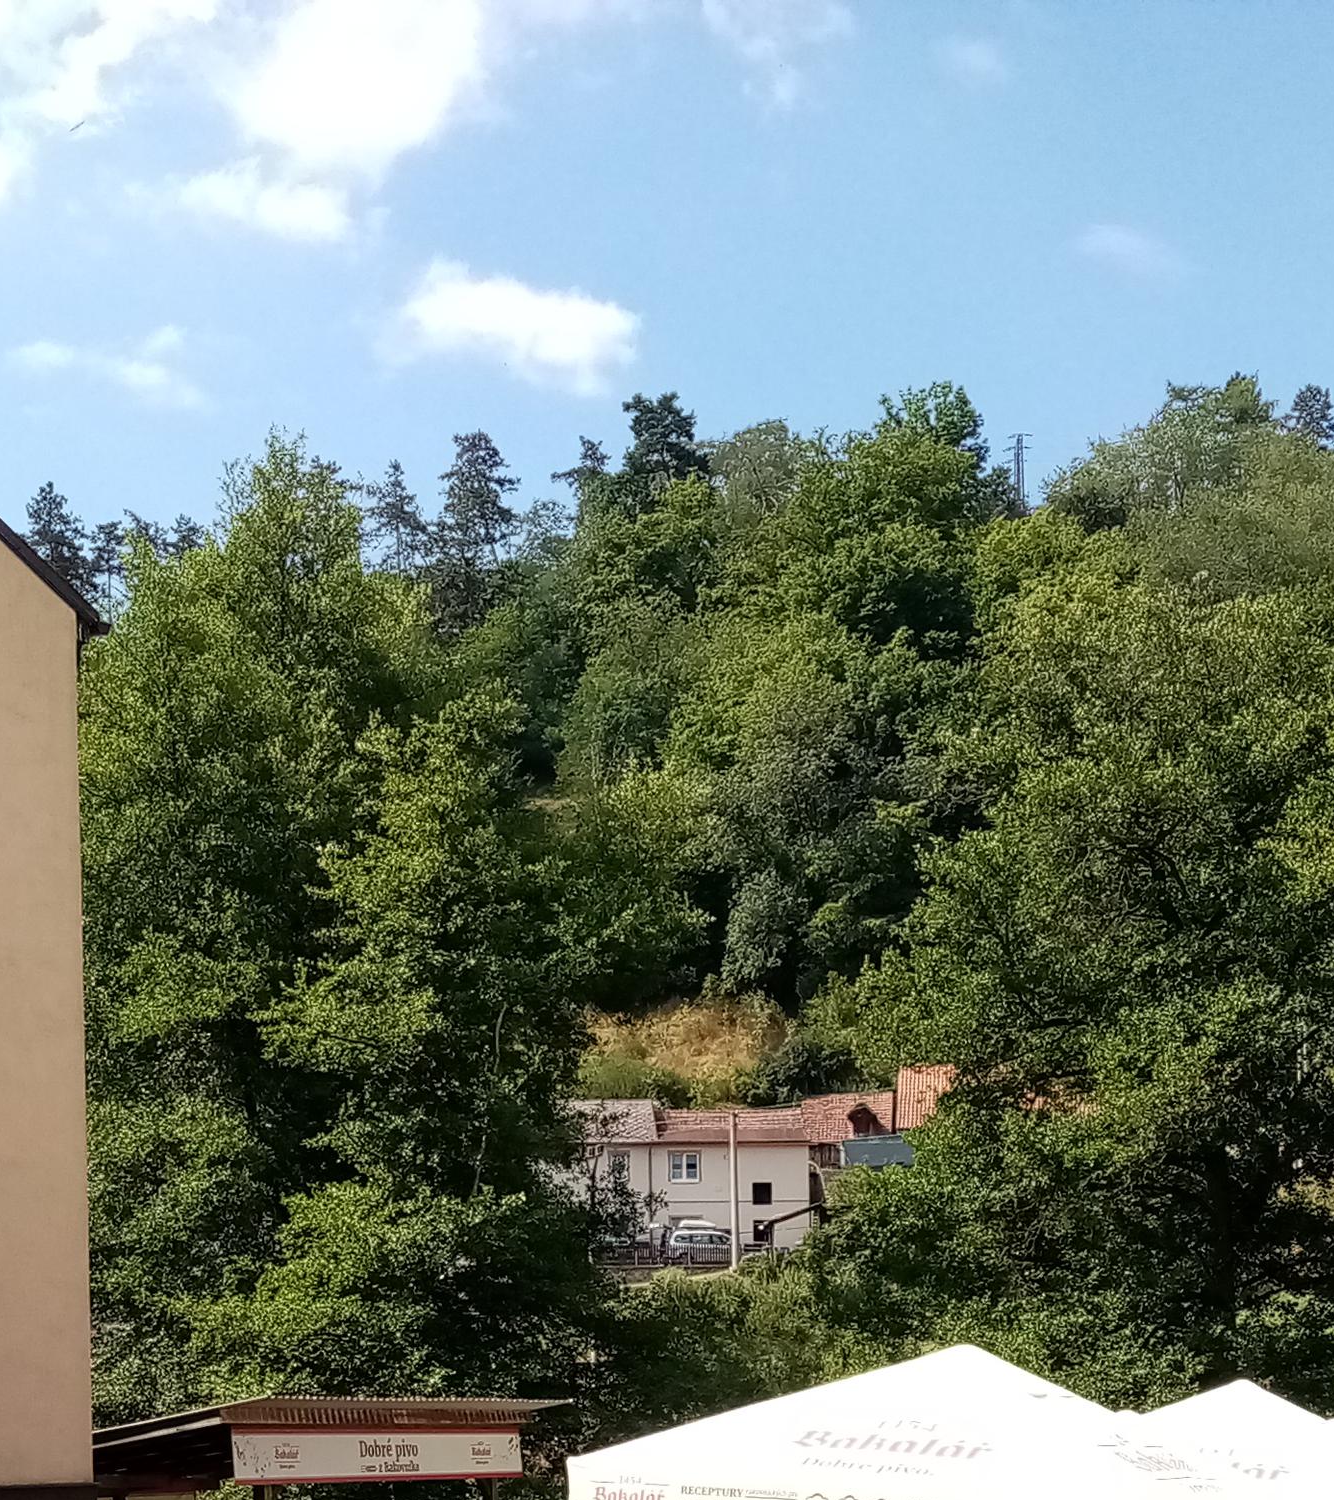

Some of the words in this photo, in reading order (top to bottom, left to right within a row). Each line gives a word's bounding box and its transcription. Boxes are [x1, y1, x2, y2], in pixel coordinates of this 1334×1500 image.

[358, 1437, 392, 1458] Dobré
[395, 1438, 419, 1462] pivo
[680, 1485, 743, 1498] RECEPTURY
